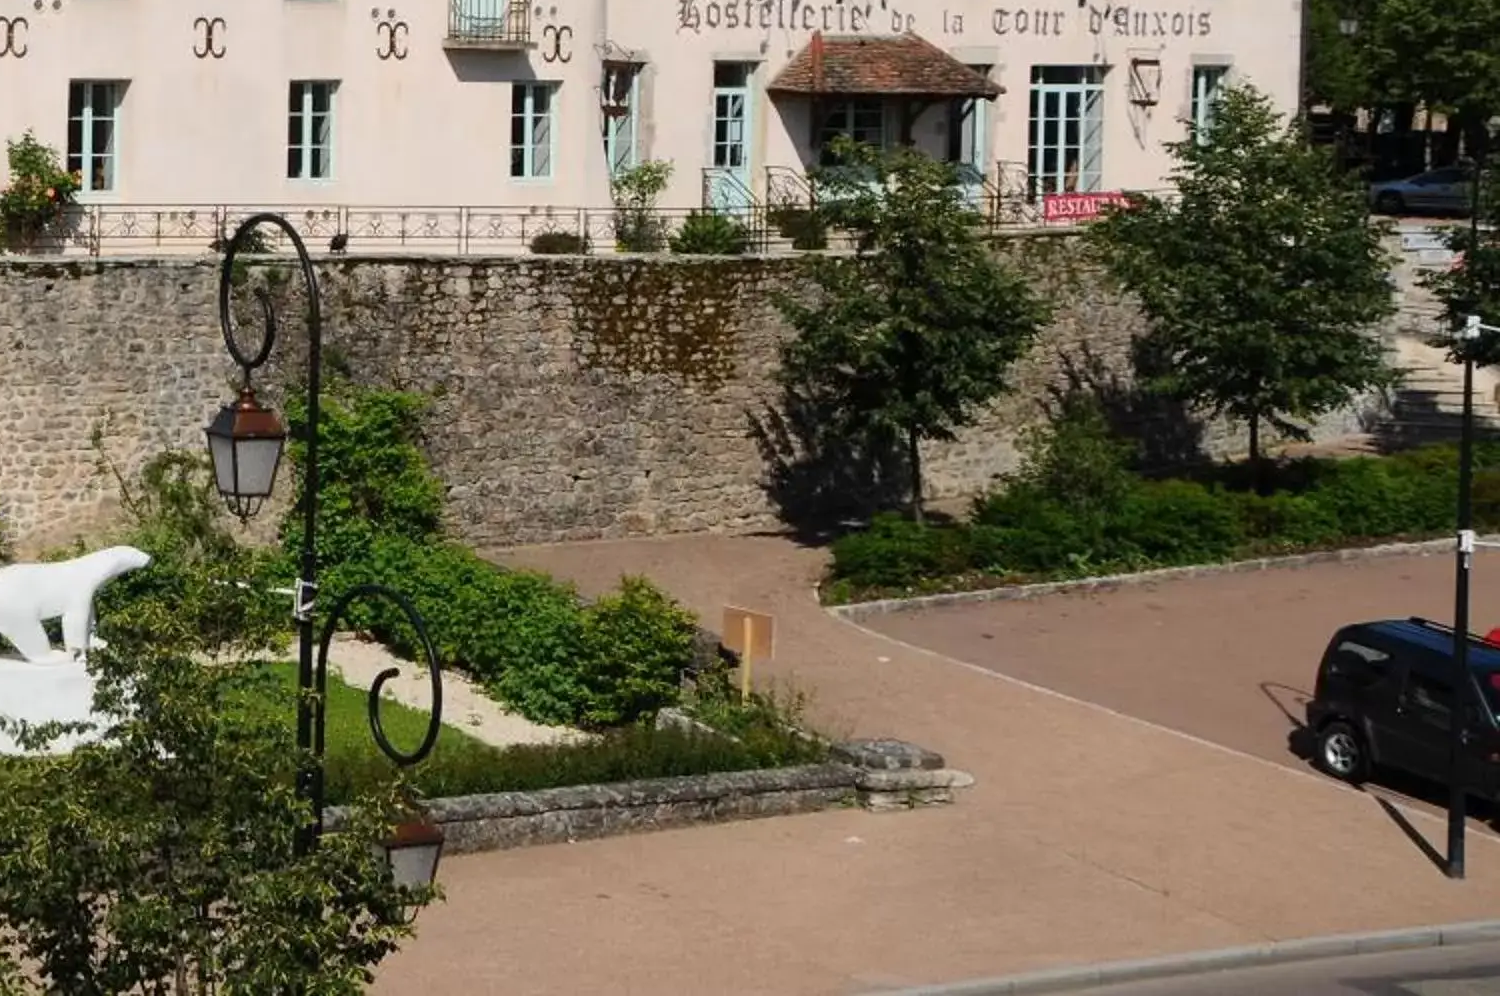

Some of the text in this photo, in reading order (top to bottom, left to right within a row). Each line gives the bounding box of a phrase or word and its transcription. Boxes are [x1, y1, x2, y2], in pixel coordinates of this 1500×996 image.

[891, 8, 915, 32] de
[942, 9, 964, 34] la
[992, 8, 1065, 36] Tour
[1088, 4, 1211, 36] d'Auxois
